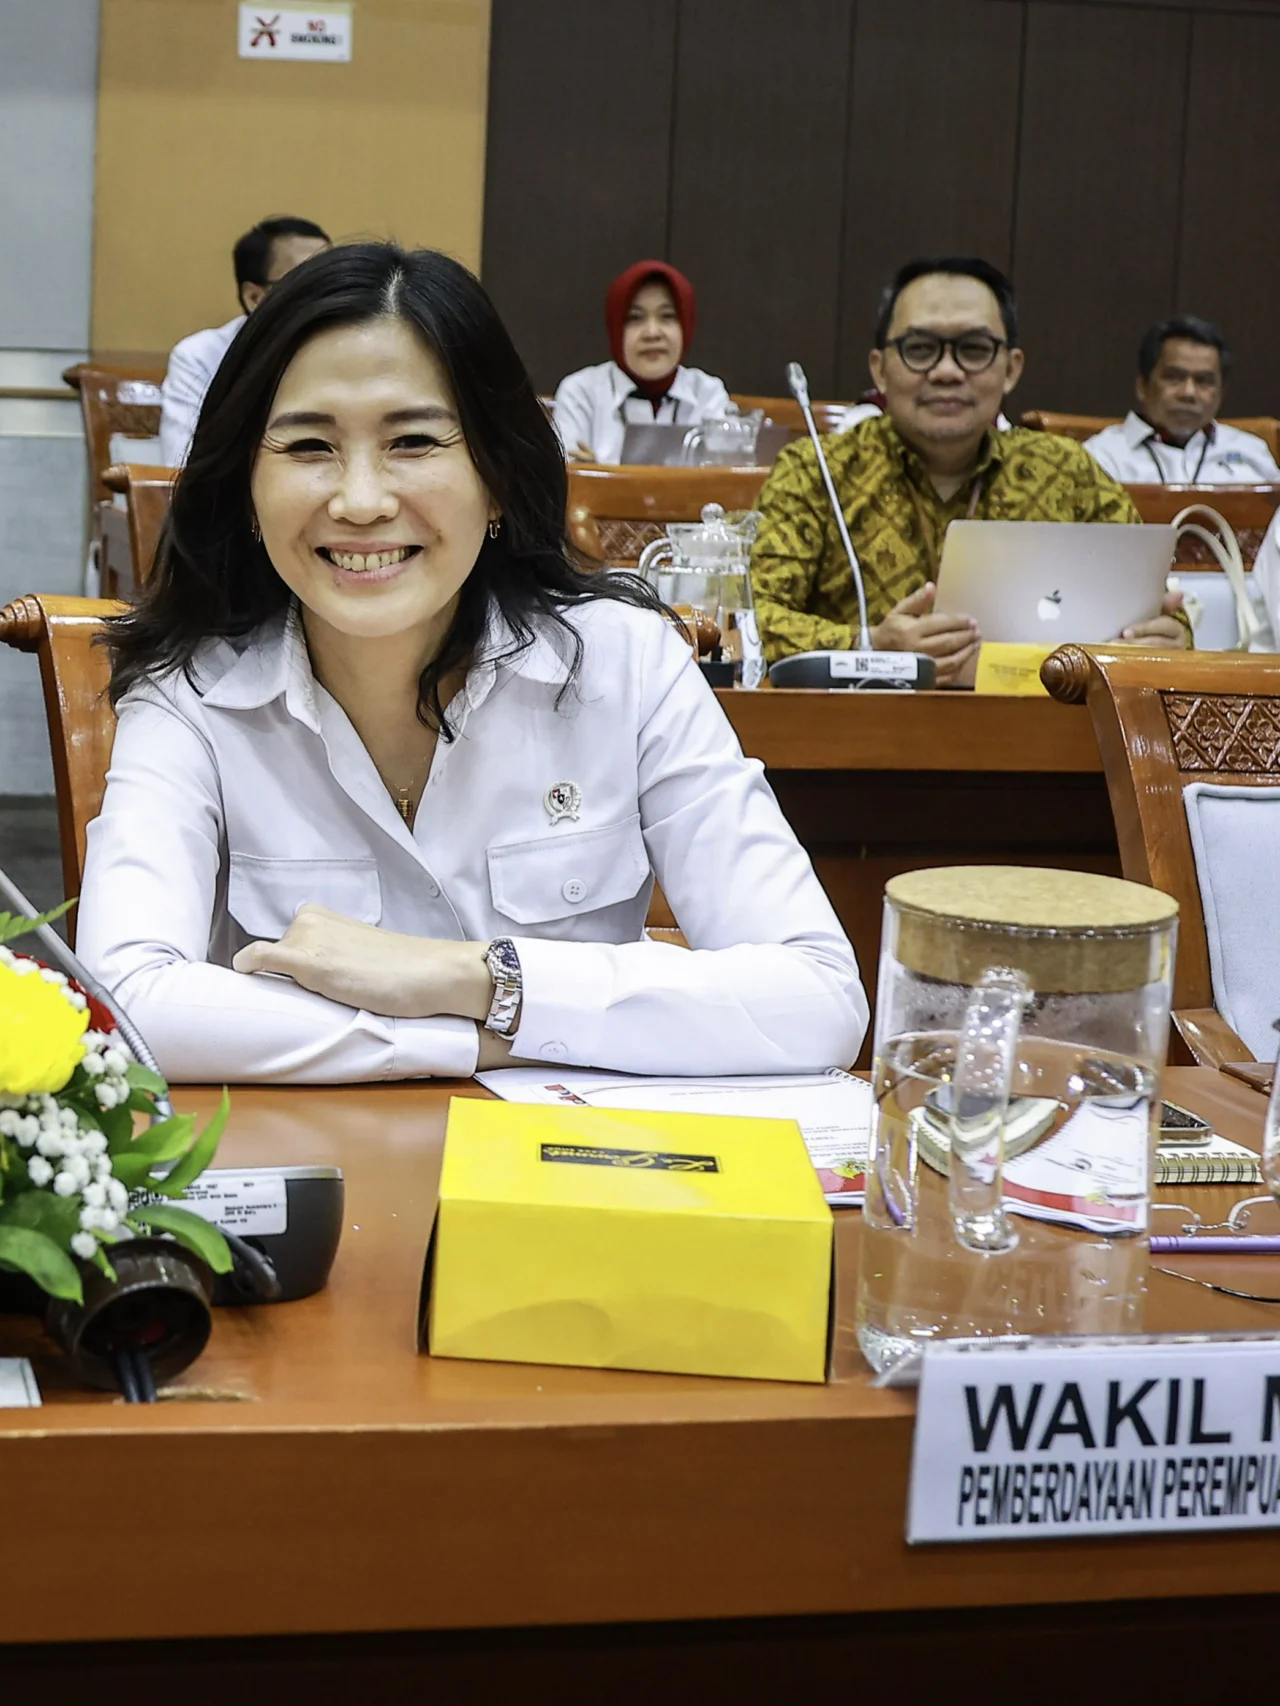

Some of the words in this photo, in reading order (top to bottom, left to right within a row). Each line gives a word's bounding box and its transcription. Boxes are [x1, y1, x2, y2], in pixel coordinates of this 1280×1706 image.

[964, 1378, 1232, 1452] WAKIL
[956, 1458, 1158, 1527] PEMBERDAYAAN
[1160, 1454, 1280, 1519] PEREMPU
